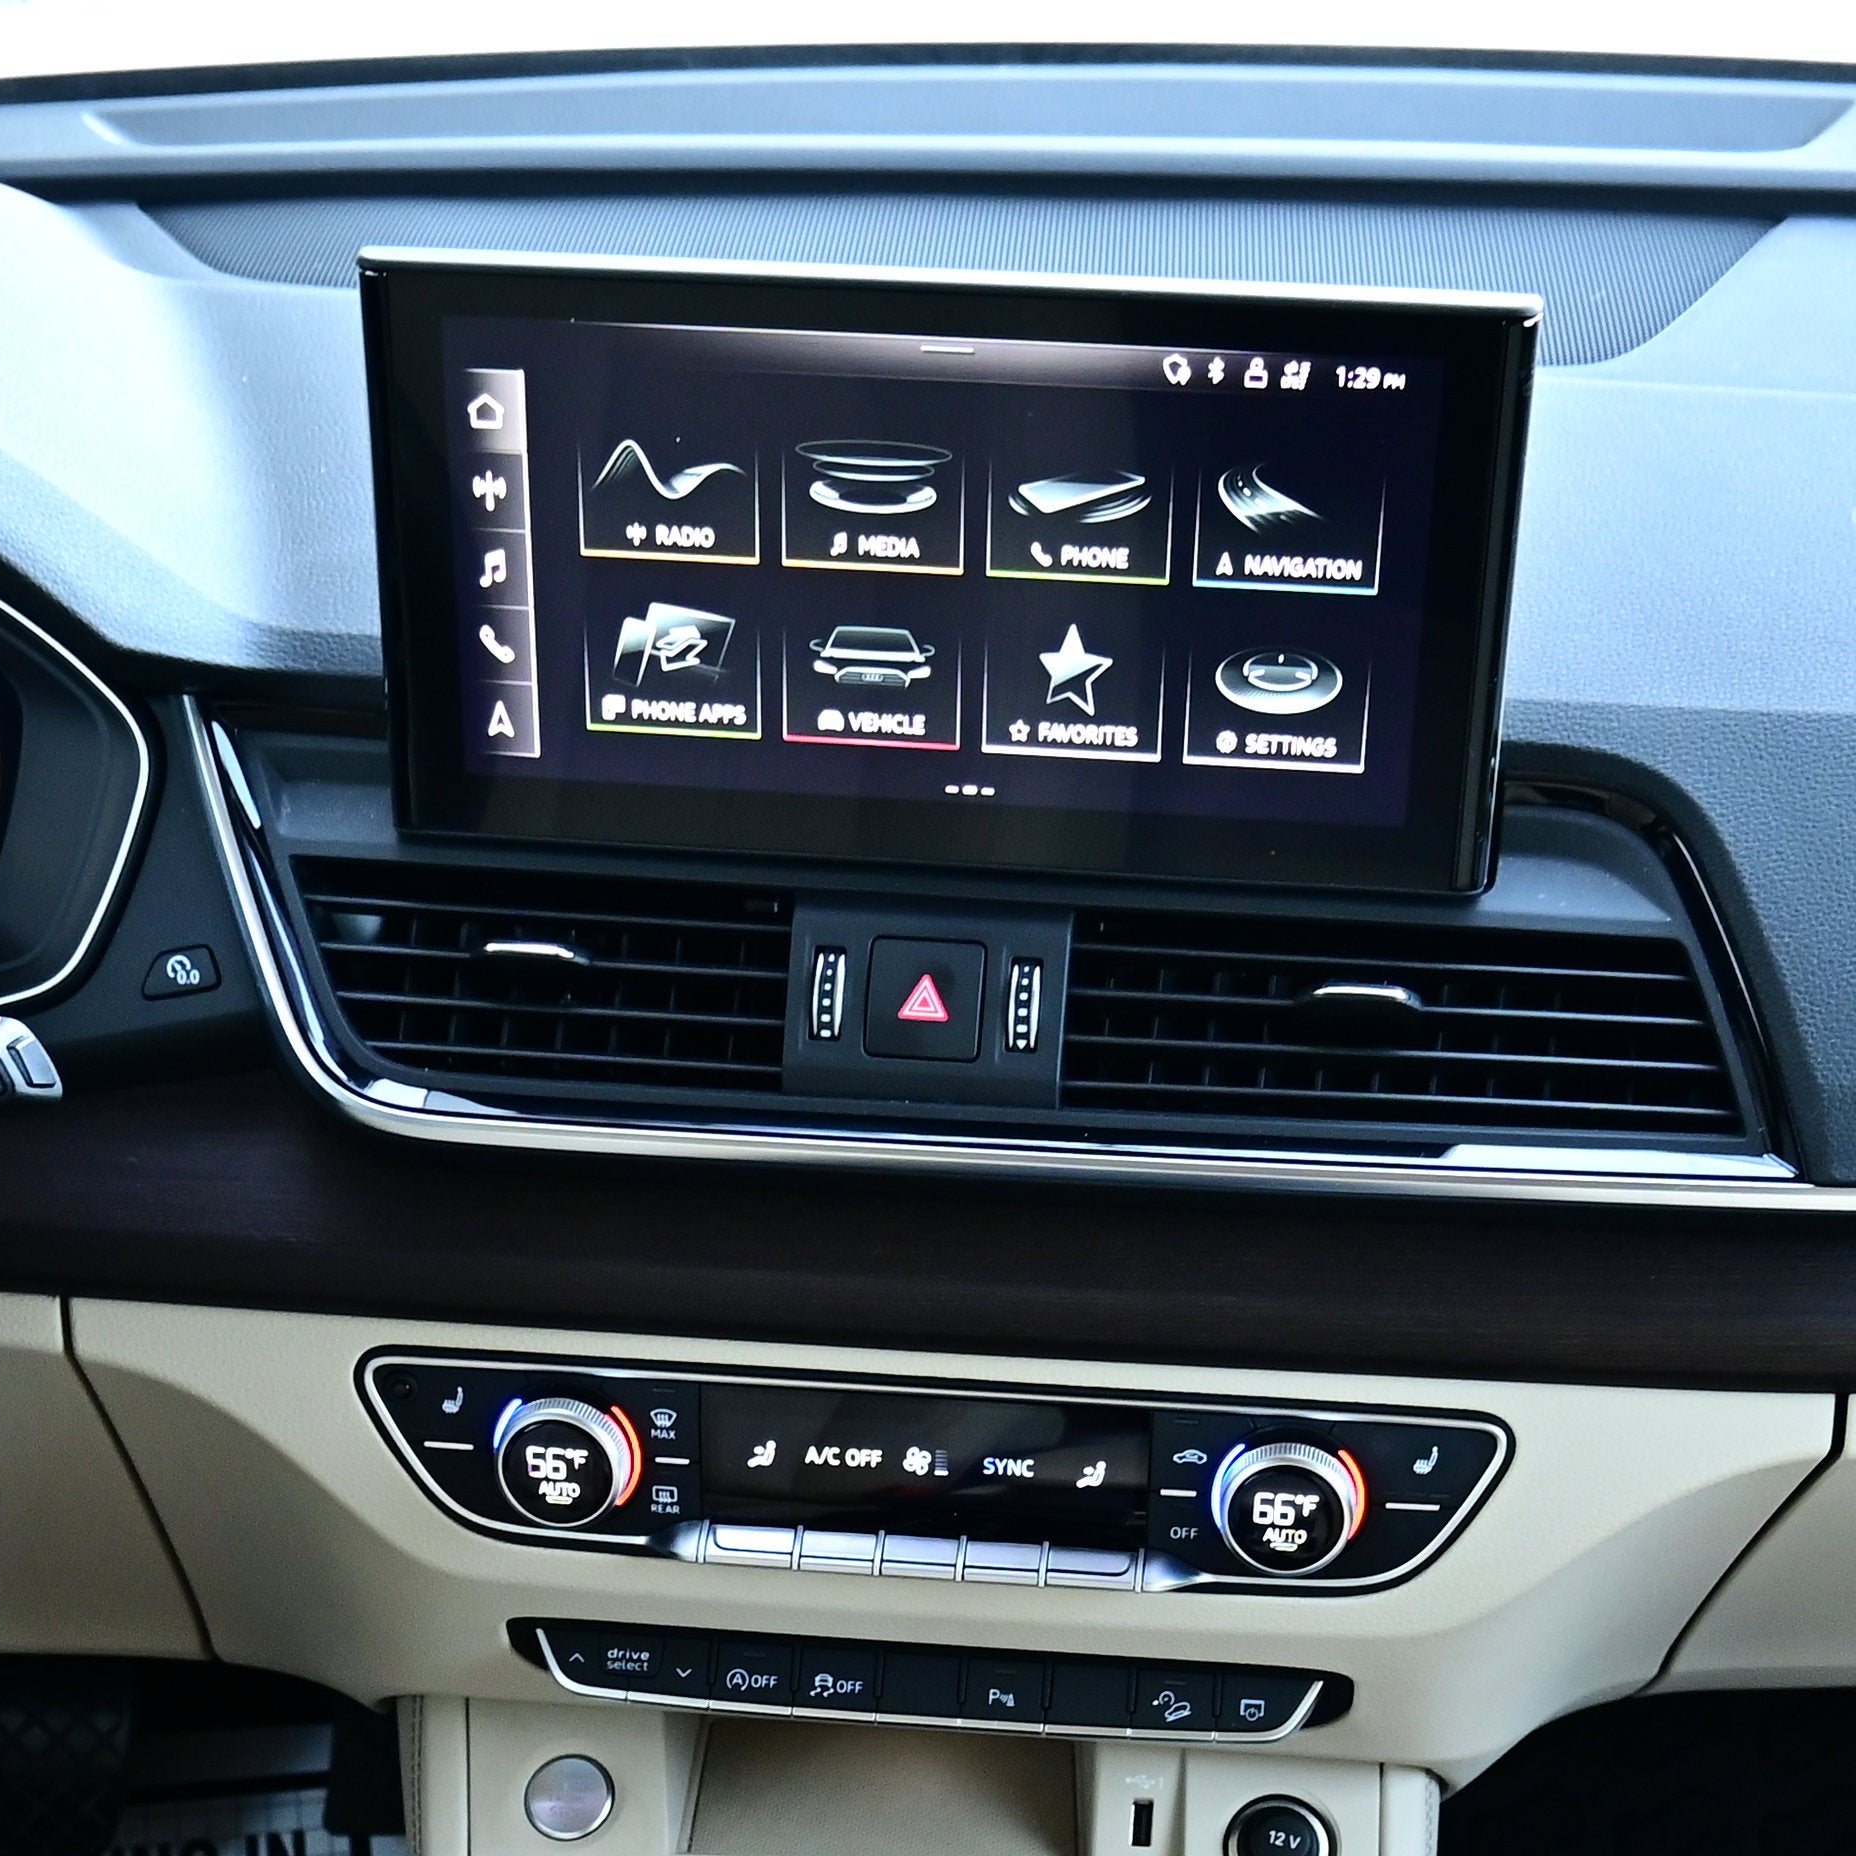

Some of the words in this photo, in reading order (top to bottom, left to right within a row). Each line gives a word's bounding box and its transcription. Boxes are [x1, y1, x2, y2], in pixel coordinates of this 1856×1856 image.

[655, 525, 715, 548] RADIO
[858, 534, 920, 559] MEDIA
[1060, 545, 1130, 570] PHONE
[1244, 554, 1363, 582] NAVIGATION
[631, 698, 697, 723] PHONE
[697, 703, 747, 726] APPS
[847, 711, 926, 736] VEHICLE
[1037, 721, 1139, 747] FAVORITES
[1245, 736, 1337, 759] SETTINGS
[650, 1428, 677, 1441] MAX
[804, 1445, 841, 1467] A/C
[845, 1448, 883, 1468] OFF
[982, 1457, 1035, 1479] SYNC
[538, 1480, 581, 1498] AUTO
[650, 1503, 681, 1515] REAR
[1170, 1526, 1198, 1540] OFF
[1262, 1527, 1307, 1545] AUTO
[607, 1646, 650, 1662] drive
[606, 1658, 649, 1673] select
[750, 1674, 778, 1690] OFF
[836, 1679, 864, 1695] OFF
[989, 1688, 1001, 1706] P
[1269, 1830, 1286, 1847] 12
[1289, 1834, 1302, 1850] V
